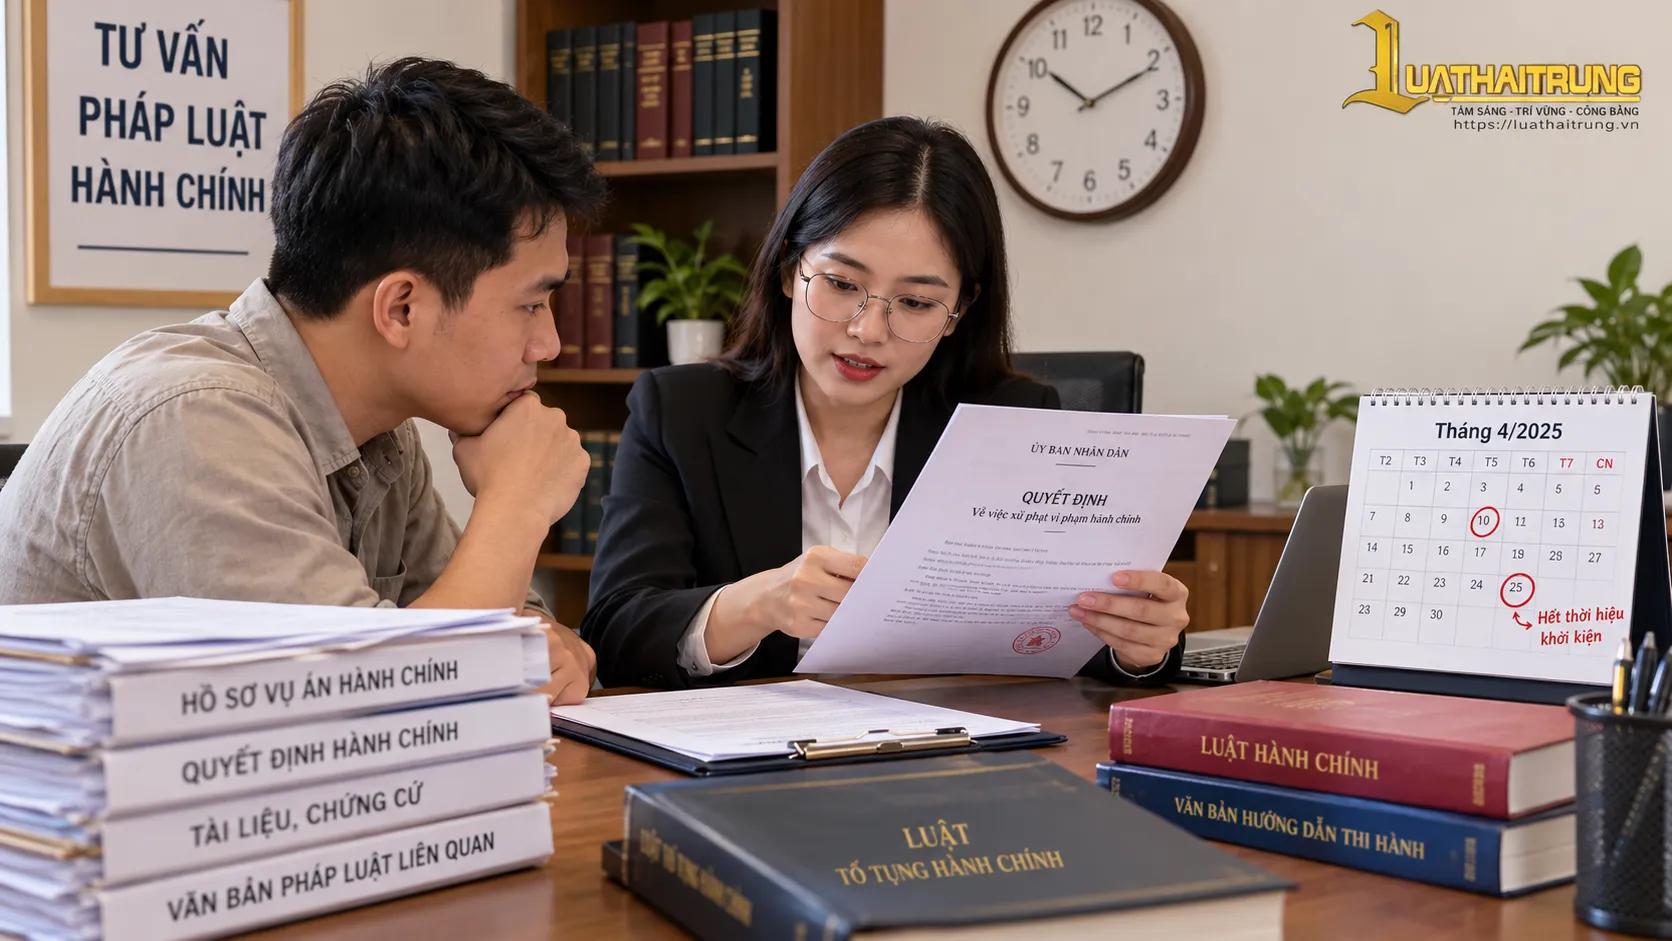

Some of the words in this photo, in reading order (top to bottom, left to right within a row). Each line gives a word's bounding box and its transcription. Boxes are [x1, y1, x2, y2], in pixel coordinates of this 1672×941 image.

[1083, 15, 1103, 36] 12
[1123, 24, 1131, 44] 1
[94, 21, 147, 70] TƯ
[156, 19, 228, 80] VẤN
[1053, 30, 1067, 49] 11
[1028, 58, 1048, 79] 10
[1147, 50, 1160, 71] 2
[1018, 96, 1030, 118] 9
[1156, 89, 1169, 110] 3
[79, 90, 175, 142] PHÁP
[187, 99, 267, 158] LUẬT
[1026, 134, 1039, 154] 8
[1144, 130, 1157, 150] 4
[1051, 161, 1063, 182] 7
[1118, 159, 1131, 180] 5
[71, 157, 165, 208] HÀNH
[176, 166, 265, 213] CHÍNH
[1084, 170, 1096, 192] 6
[1435, 422, 1492, 443] Tháng
[1497, 423, 1563, 440] 4/2025
[1049, 446, 1072, 454] BAN
[1380, 456, 1392, 466] T2
[1414, 456, 1426, 466] T3
[1449, 457, 1462, 466] T4
[1485, 458, 1498, 467] T5
[1522, 458, 1535, 468] T6
[1560, 458, 1574, 468] T7
[1596, 459, 1613, 468] CN
[1409, 481, 1414, 490] 1
[1444, 482, 1450, 491] 2
[1480, 482, 1486, 492] 3
[1517, 483, 1524, 492] 4
[1022, 488, 1071, 505] QUYẾT
[1072, 494, 1108, 508] ĐỊNH
[1024, 512, 1048, 523] phạt
[1051, 512, 1060, 522] vi
[1060, 514, 1088, 525] phạm
[1370, 512, 1376, 520] 7
[1405, 513, 1410, 522] 8
[1441, 514, 1447, 524] 9
[1478, 516, 1490, 526] 10
[1592, 519, 1604, 529] 13
[1367, 543, 1378, 552] 14
[1402, 544, 1413, 554] 15
[1438, 546, 1449, 555] 16
[1475, 548, 1486, 557] 17
[1588, 552, 1602, 563] 27
[1362, 574, 1374, 584] 21
[1398, 576, 1410, 586] 22
[1434, 578, 1446, 588] 23
[1470, 580, 1482, 590] 24
[1510, 582, 1522, 592] 25
[1358, 605, 1370, 614] 23
[1394, 607, 1406, 617] 29
[1430, 610, 1442, 620] 30
[1538, 608, 1560, 624] Hết
[1566, 608, 1591, 622] thời
[1596, 606, 1624, 624] hiệu
[1574, 629, 1602, 646] kiện
[182, 683, 217, 715] HỒ
[226, 682, 258, 709] SƠ
[264, 680, 295, 708] VỤ
[302, 671, 331, 700] ÁN
[340, 664, 394, 694] HÀNH
[401, 658, 458, 686] CHÍNH
[182, 744, 262, 784] QUYẾT
[270, 741, 324, 772] ĐỊNH
[333, 729, 392, 760] HÀNH
[398, 720, 458, 749] CHÍNH
[1201, 734, 1249, 762] LUẬT
[1254, 740, 1309, 770] HÀNH
[1315, 751, 1379, 780] CHÍNH
[190, 818, 228, 848] TÀI
[239, 807, 298, 838] LIỆU,
[307, 792, 386, 825] CHỨNG
[394, 781, 424, 806] CỨ
[902, 818, 970, 851] LUẬT
[1174, 796, 1203, 816] VĂN
[1208, 800, 1238, 823] BẢN
[1242, 810, 1298, 836] HƯỚNG
[1302, 816, 1336, 843] DẪN
[1342, 828, 1370, 849] THI
[1376, 832, 1425, 860] HÀNH
[227, 877, 272, 910] BẢN
[282, 863, 336, 897] PHÁP
[344, 852, 392, 881] LUẬT
[400, 842, 438, 871] LIÊN
[446, 832, 494, 861] QUAN
[834, 859, 867, 886] TỐ
[868, 862, 929, 886] TỤNG
[931, 854, 994, 878] HÀNH
[996, 848, 1064, 873] CHÍNH
